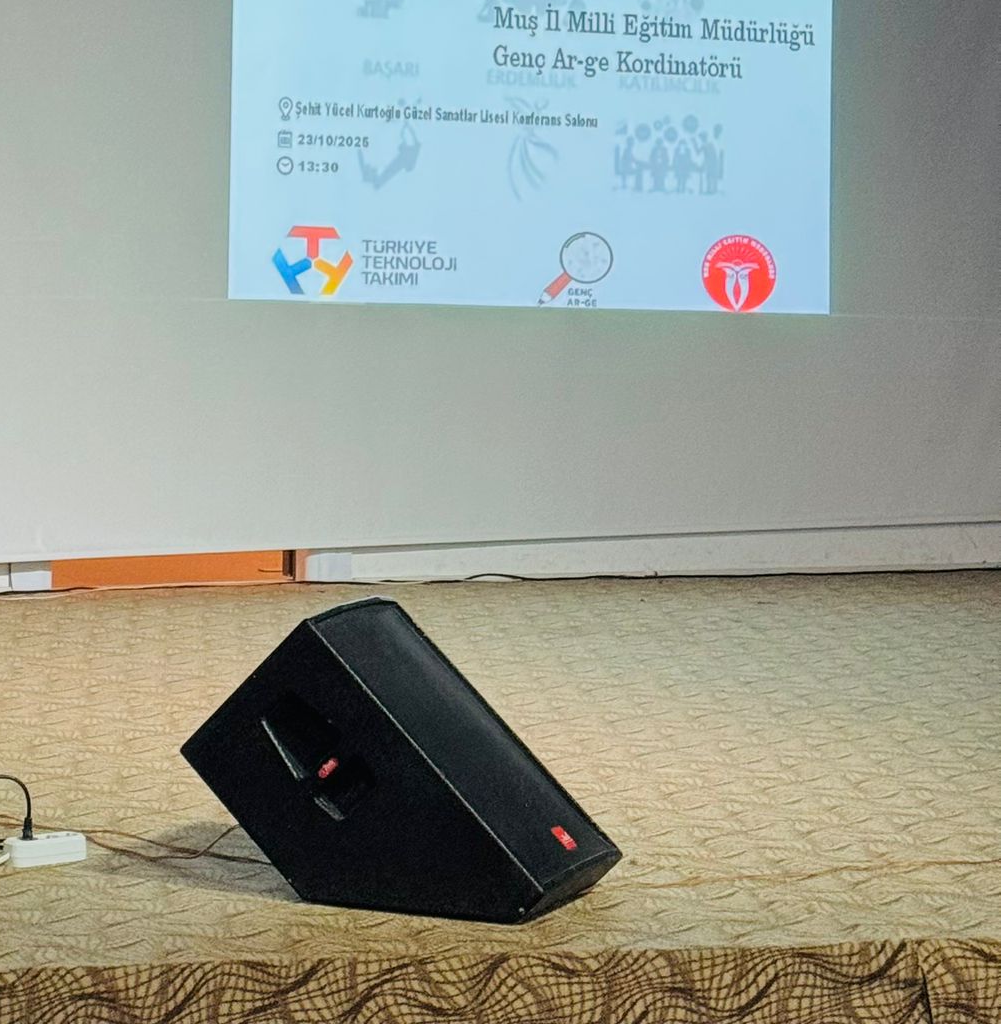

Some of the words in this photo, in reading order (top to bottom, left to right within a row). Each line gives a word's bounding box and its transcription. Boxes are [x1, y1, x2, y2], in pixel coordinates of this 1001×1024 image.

[493, 6, 538, 37] Muş
[545, 3, 561, 32] İl
[567, 10, 616, 35] Milli
[623, 13, 693, 43] Eğitim
[700, 18, 816, 51] Müdürlüğü
[493, 44, 546, 75] Genç
[552, 48, 609, 77] Ar-ge
[616, 50, 743, 79] Kordinatörü
[325, 102, 354, 118] Yücel
[403, 106, 432, 121] Güzel
[435, 107, 478, 123] Sanatlar
[512, 111, 562, 127] Konferans
[298, 160, 339, 173] 13:30
[361, 271, 418, 287] TAKIMI
